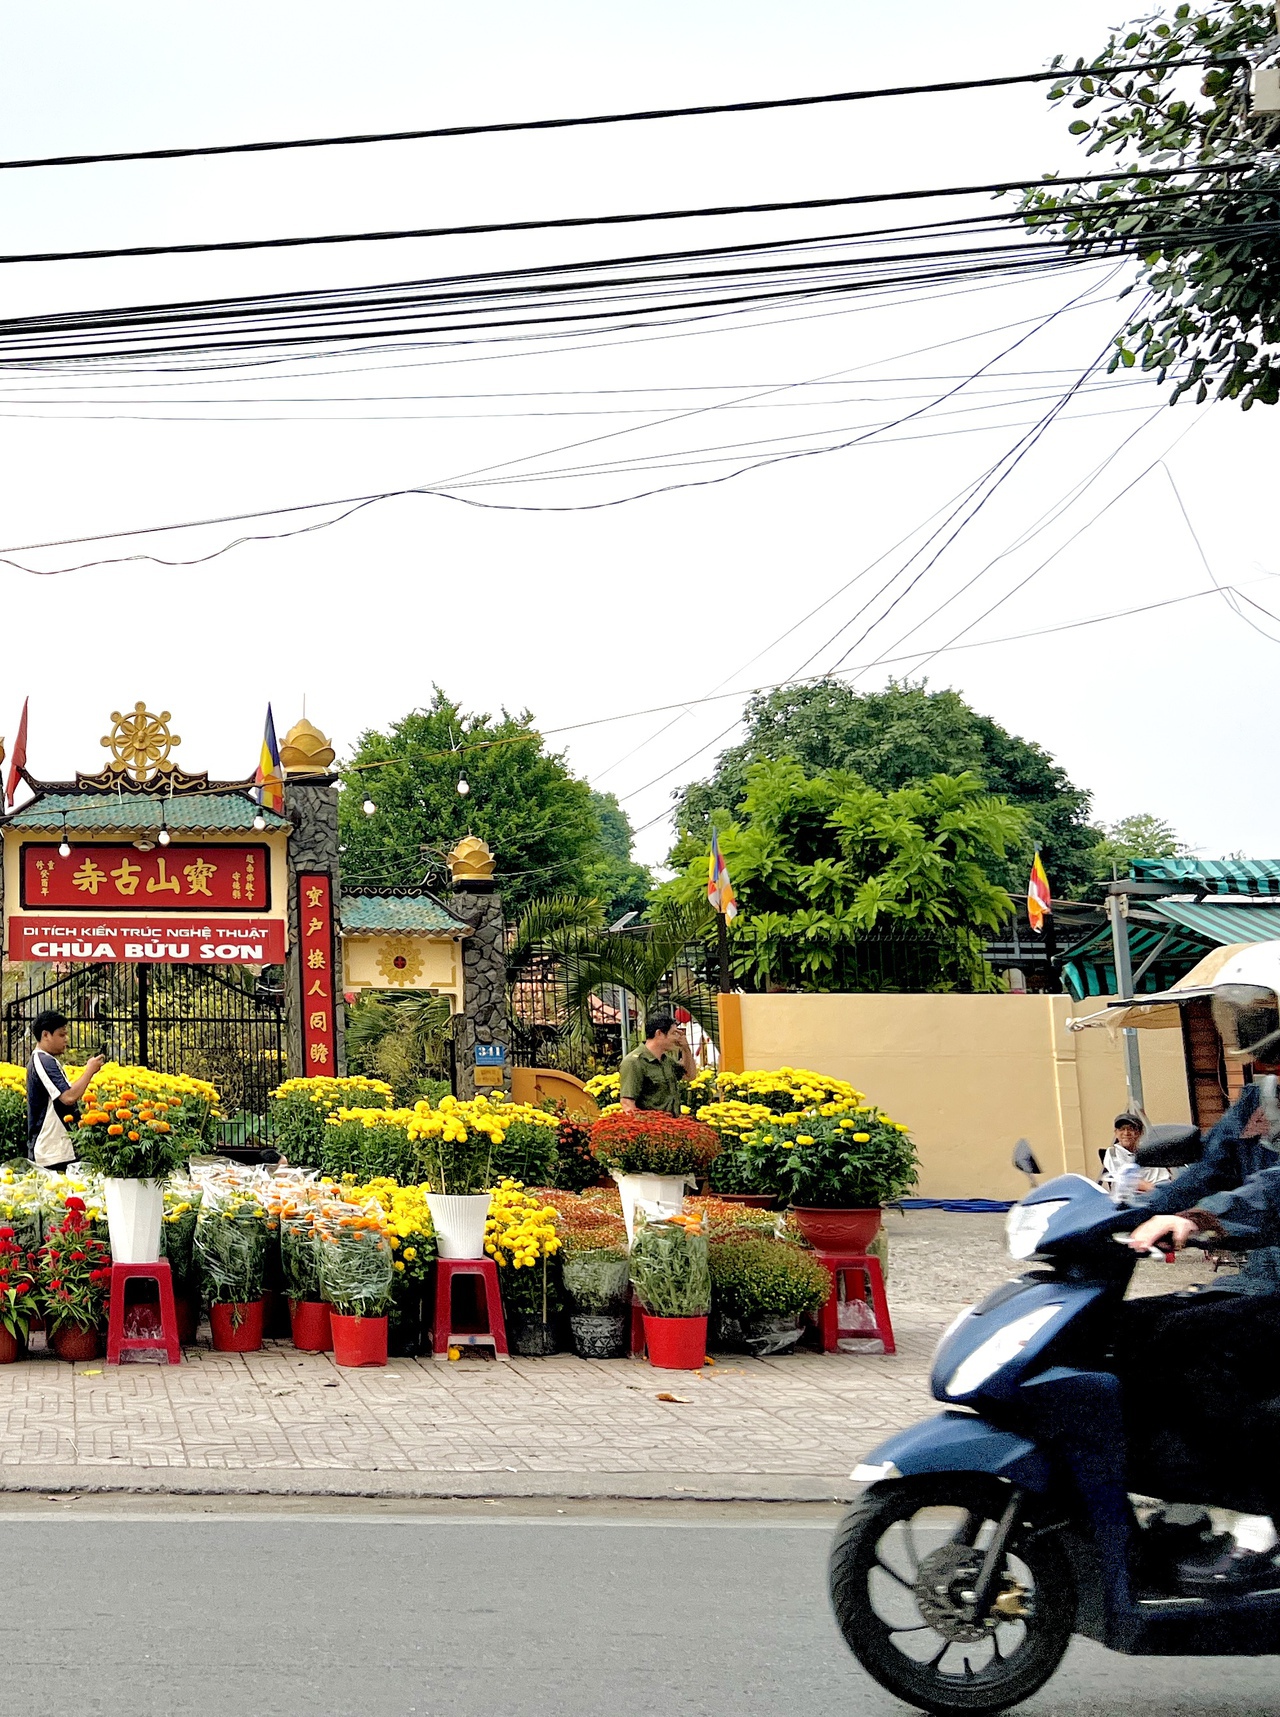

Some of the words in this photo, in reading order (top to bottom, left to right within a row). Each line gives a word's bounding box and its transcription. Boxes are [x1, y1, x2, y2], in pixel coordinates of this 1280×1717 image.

[23, 927, 38, 936] DI
[41, 925, 77, 936] TÍCH
[81, 923, 118, 937] KIẾN
[120, 926, 162, 937] TRÚC
[167, 926, 212, 940] NGHỆ
[216, 927, 269, 940] THUẬT
[31, 938, 117, 958] CHÙA
[125, 938, 190, 958] BỬU
[200, 944, 263, 959] SƠN
[478, 1046, 501, 1057] 341
